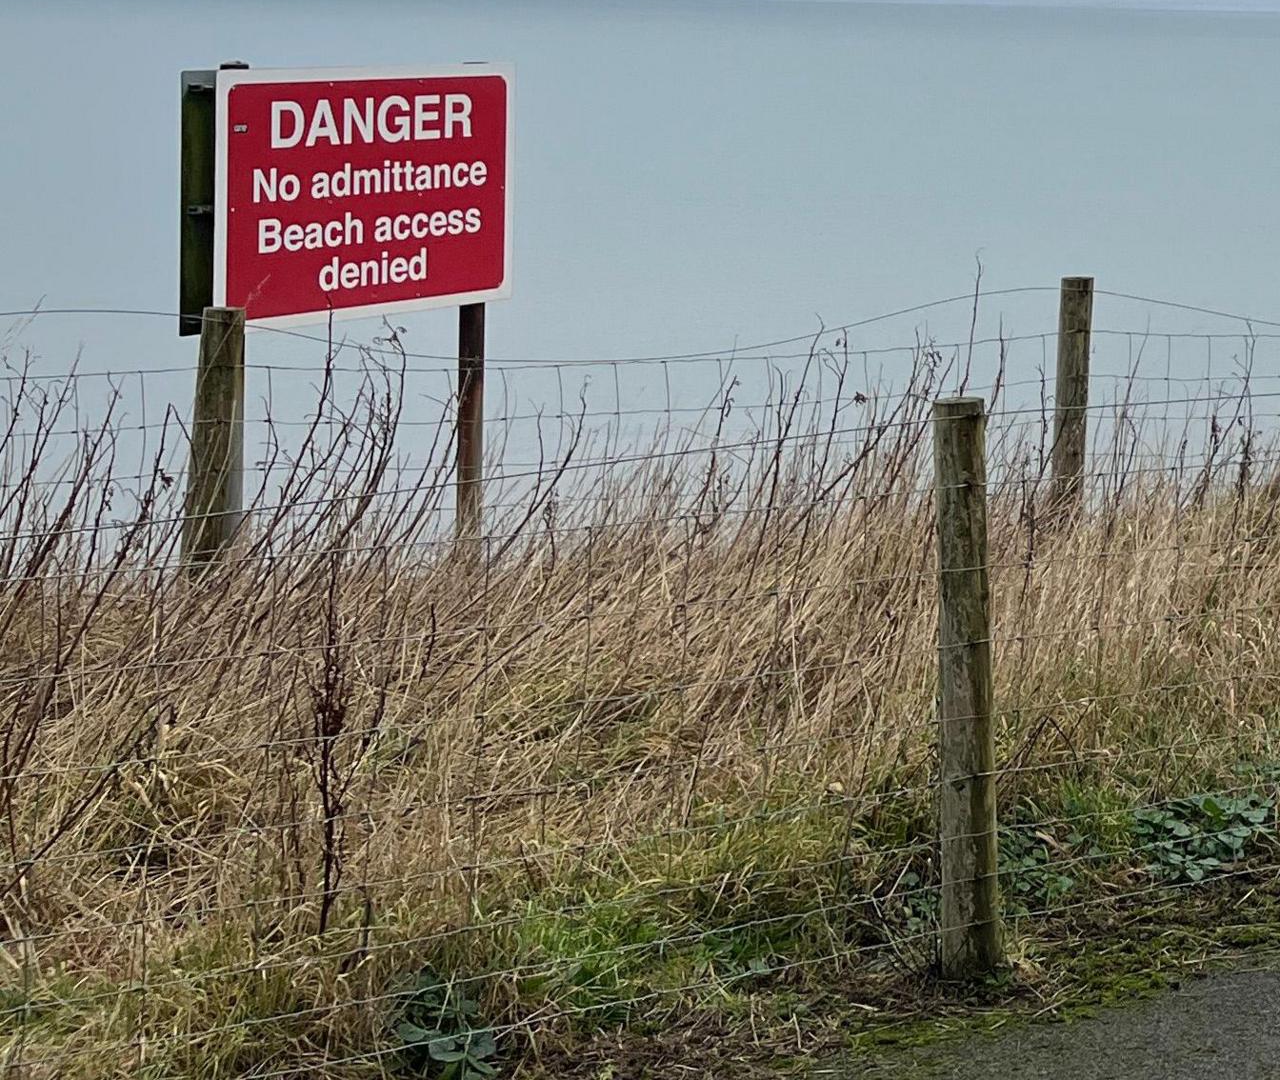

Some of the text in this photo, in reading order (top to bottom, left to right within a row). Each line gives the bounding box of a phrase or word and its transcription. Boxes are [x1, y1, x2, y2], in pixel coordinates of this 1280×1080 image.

[271, 94, 472, 148] DANGER
[254, 160, 487, 202] No admittance
[259, 208, 481, 253] Beach access
[318, 247, 427, 291] denied
